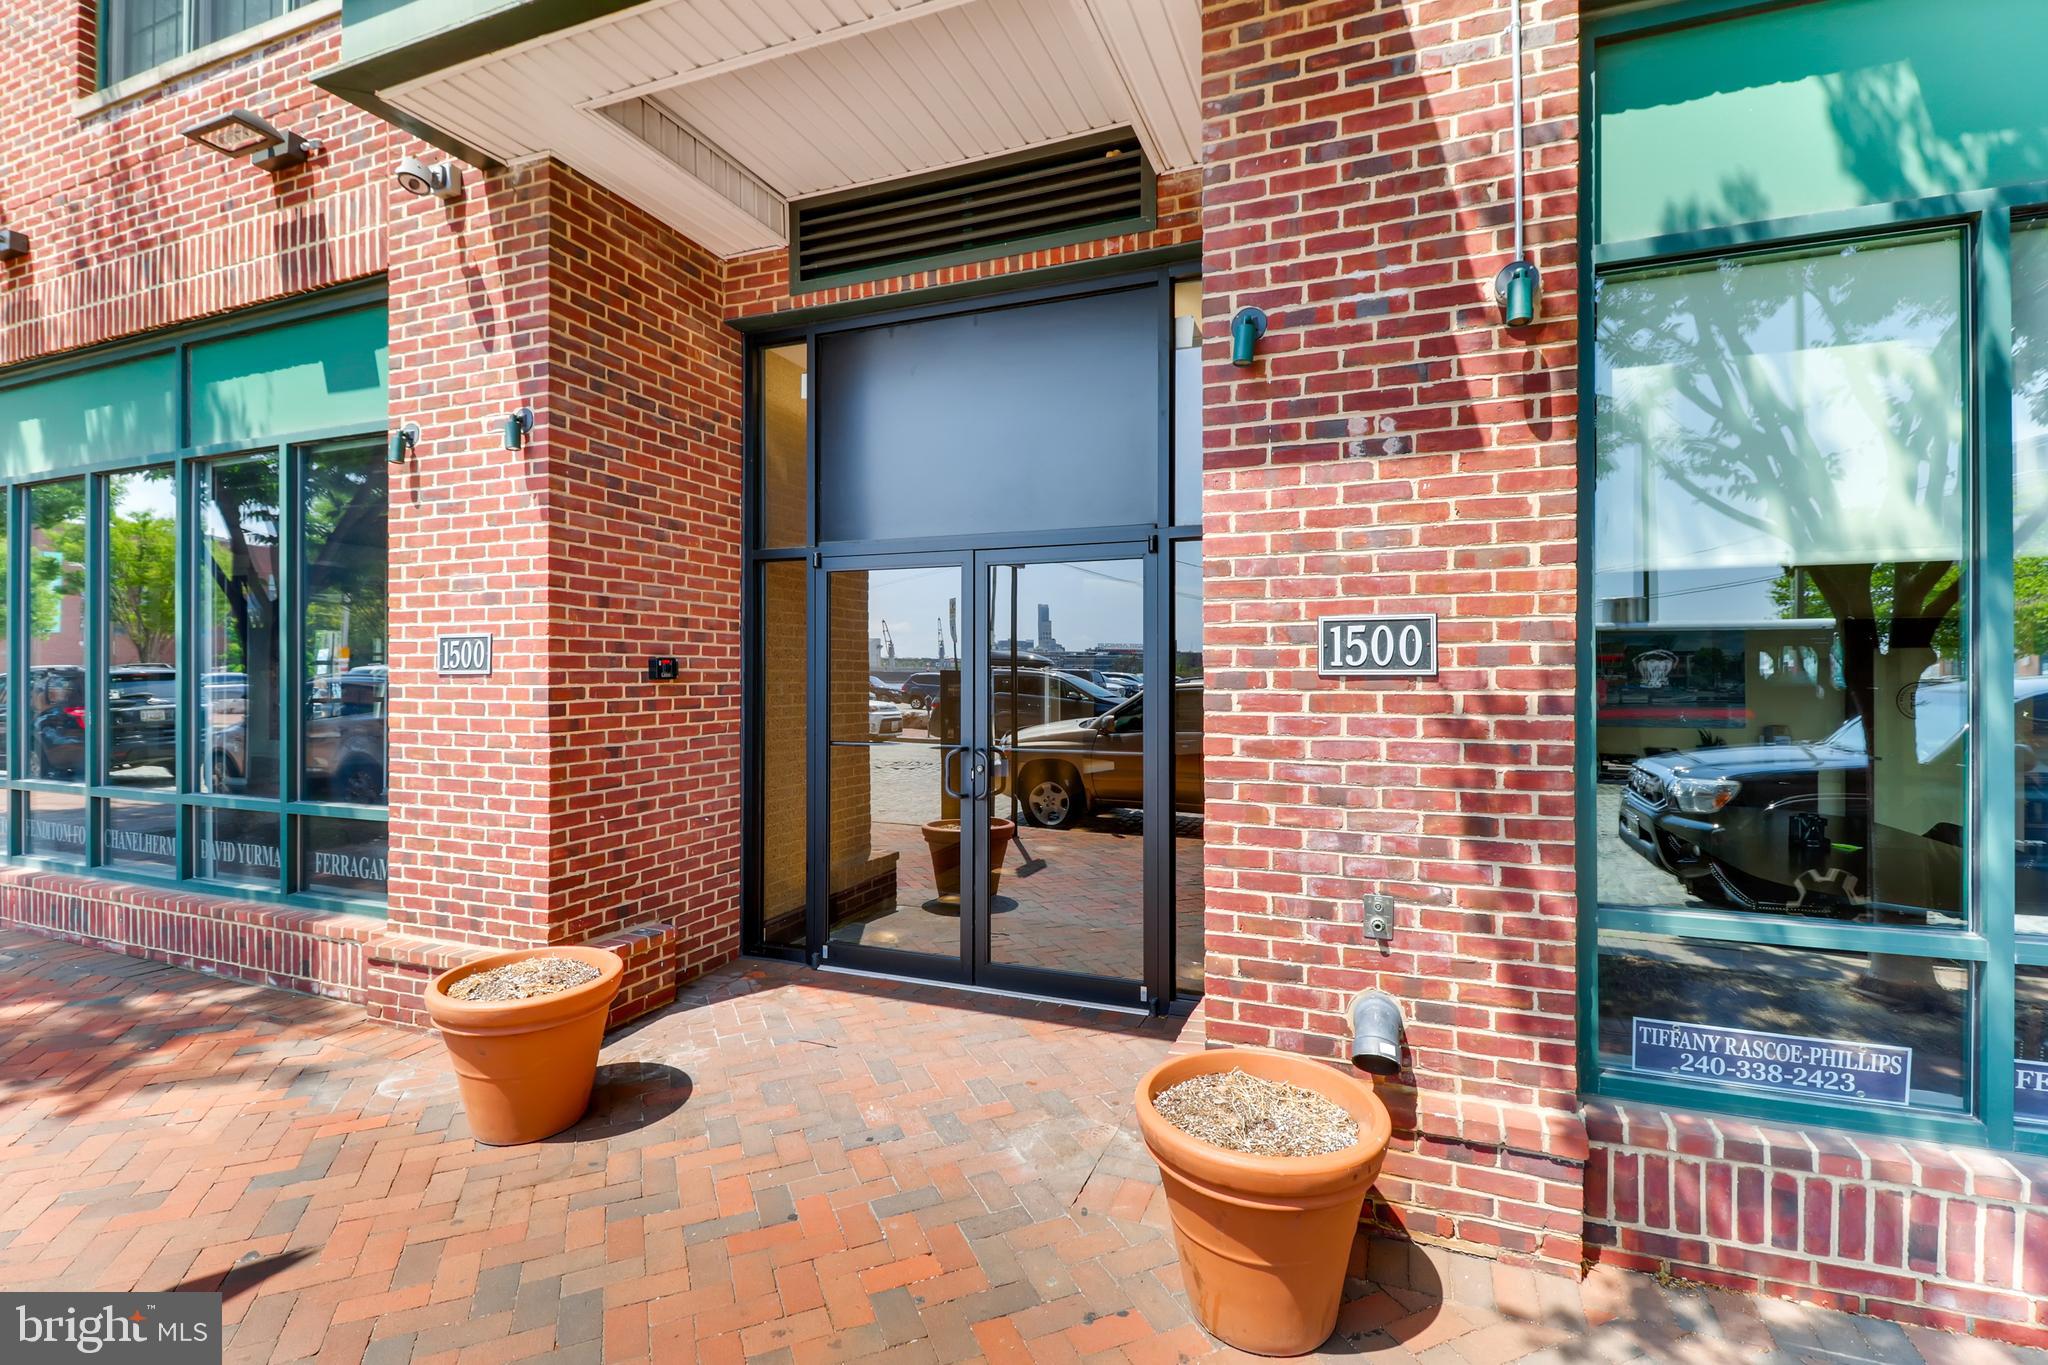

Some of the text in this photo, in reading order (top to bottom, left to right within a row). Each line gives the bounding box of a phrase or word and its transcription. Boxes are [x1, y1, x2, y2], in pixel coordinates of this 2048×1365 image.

[442, 640, 485, 669] 1500
[1330, 624, 1423, 667] 1500
[201, 839, 281, 868] DAVID YURMA
[1639, 1026, 1903, 1076] TIFFANY RASCOE-PHILLIPS
[1680, 1053, 1856, 1092] 240-338-2423
